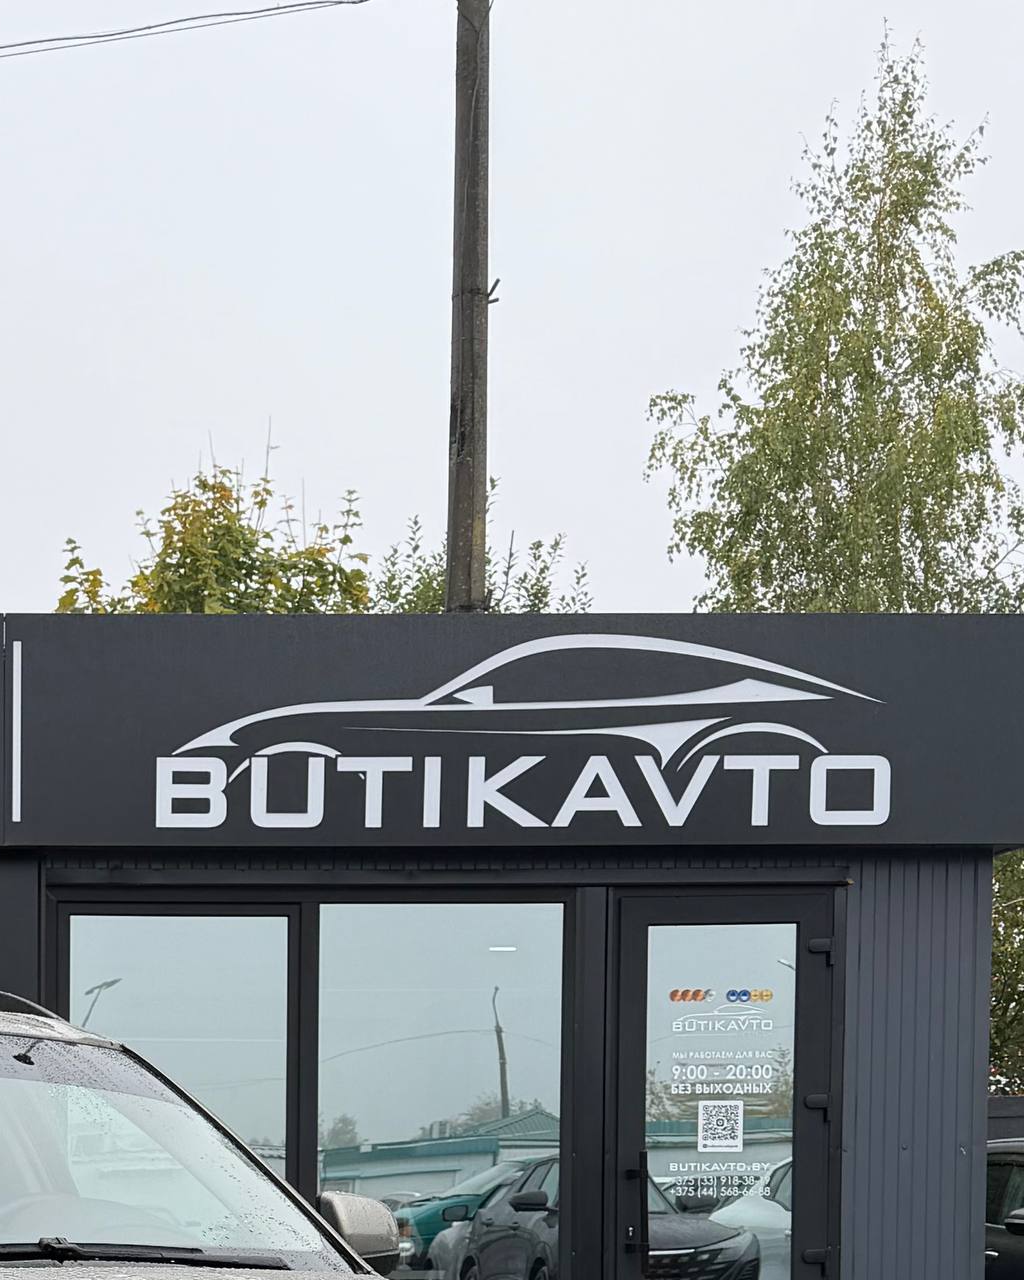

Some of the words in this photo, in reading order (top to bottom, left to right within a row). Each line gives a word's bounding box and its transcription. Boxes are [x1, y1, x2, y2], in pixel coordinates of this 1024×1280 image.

[156, 754, 892, 828] BUTIKAVTO
[672, 1019, 773, 1031] BUTIKAVTO
[672, 1051, 687, 1059] МЫ
[689, 1051, 733, 1059] РАБОТАЕМ
[736, 1051, 752, 1059] ДЛЯ
[672, 1065, 707, 1079] 9:00
[726, 1065, 773, 1079] 20:00
[671, 1083, 692, 1094] БЕЗ
[695, 1083, 773, 1095] ВЫХОДНЫХ
[669, 1162, 771, 1171] BUTIKAVTO.BY
[698, 1175, 717, 1187] (33)
[669, 1187, 695, 1197] +375
[698, 1186, 717, 1199] (44)
